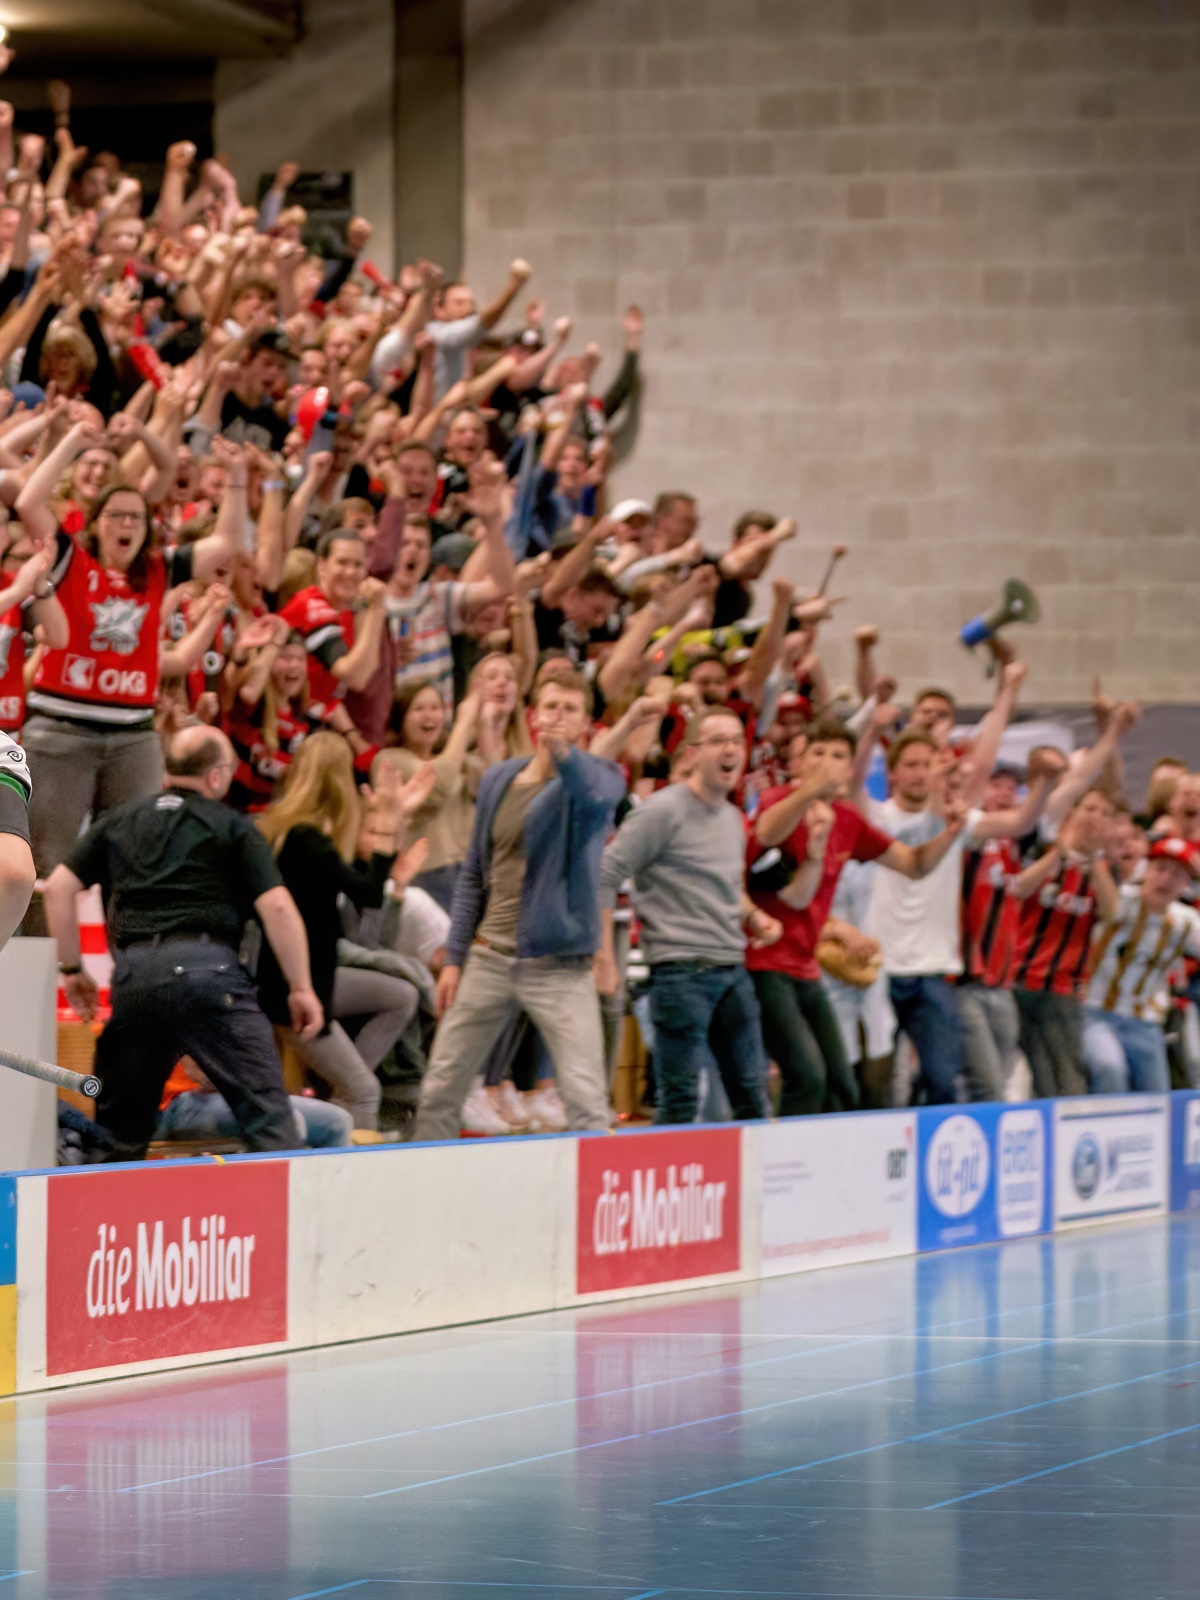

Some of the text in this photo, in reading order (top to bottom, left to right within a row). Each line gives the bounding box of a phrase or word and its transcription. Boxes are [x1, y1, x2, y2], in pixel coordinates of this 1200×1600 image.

[593, 1162, 726, 1256] die Mobiliar
[86, 1213, 255, 1319] die Mobiliar
